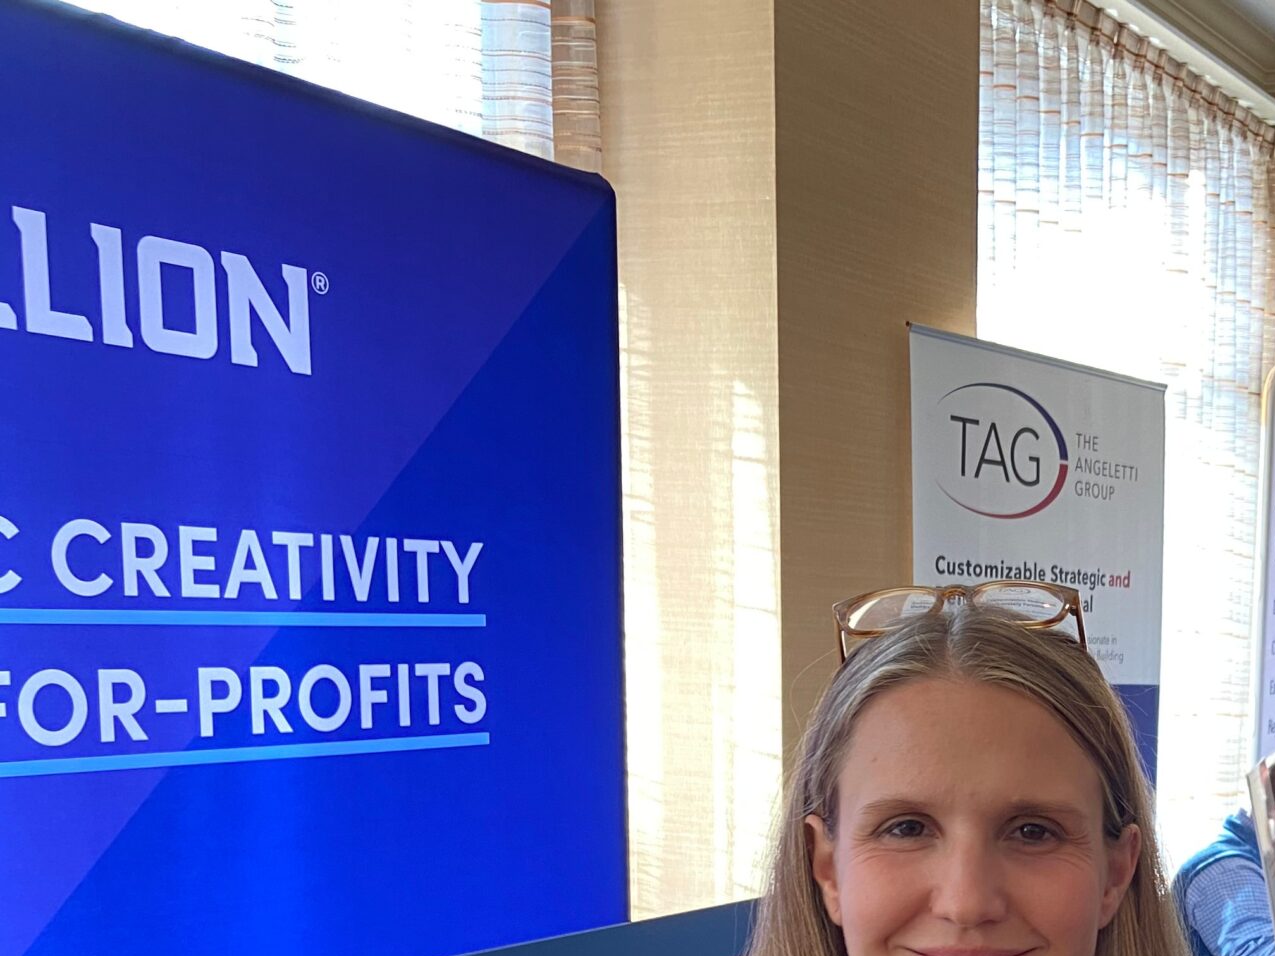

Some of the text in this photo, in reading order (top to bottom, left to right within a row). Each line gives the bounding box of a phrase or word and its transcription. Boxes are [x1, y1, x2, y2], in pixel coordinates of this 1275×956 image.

[950, 414, 1040, 487] TAG
[1076, 432, 1099, 452] THE
[1075, 459, 1139, 482] ANGELETTI
[1075, 483, 1116, 501] GROUP
[51, 517, 484, 603] CREATIVITY
[935, 556, 1131, 591] Customizable Strategic and
[0, 661, 487, 746] OR-PROFITS
